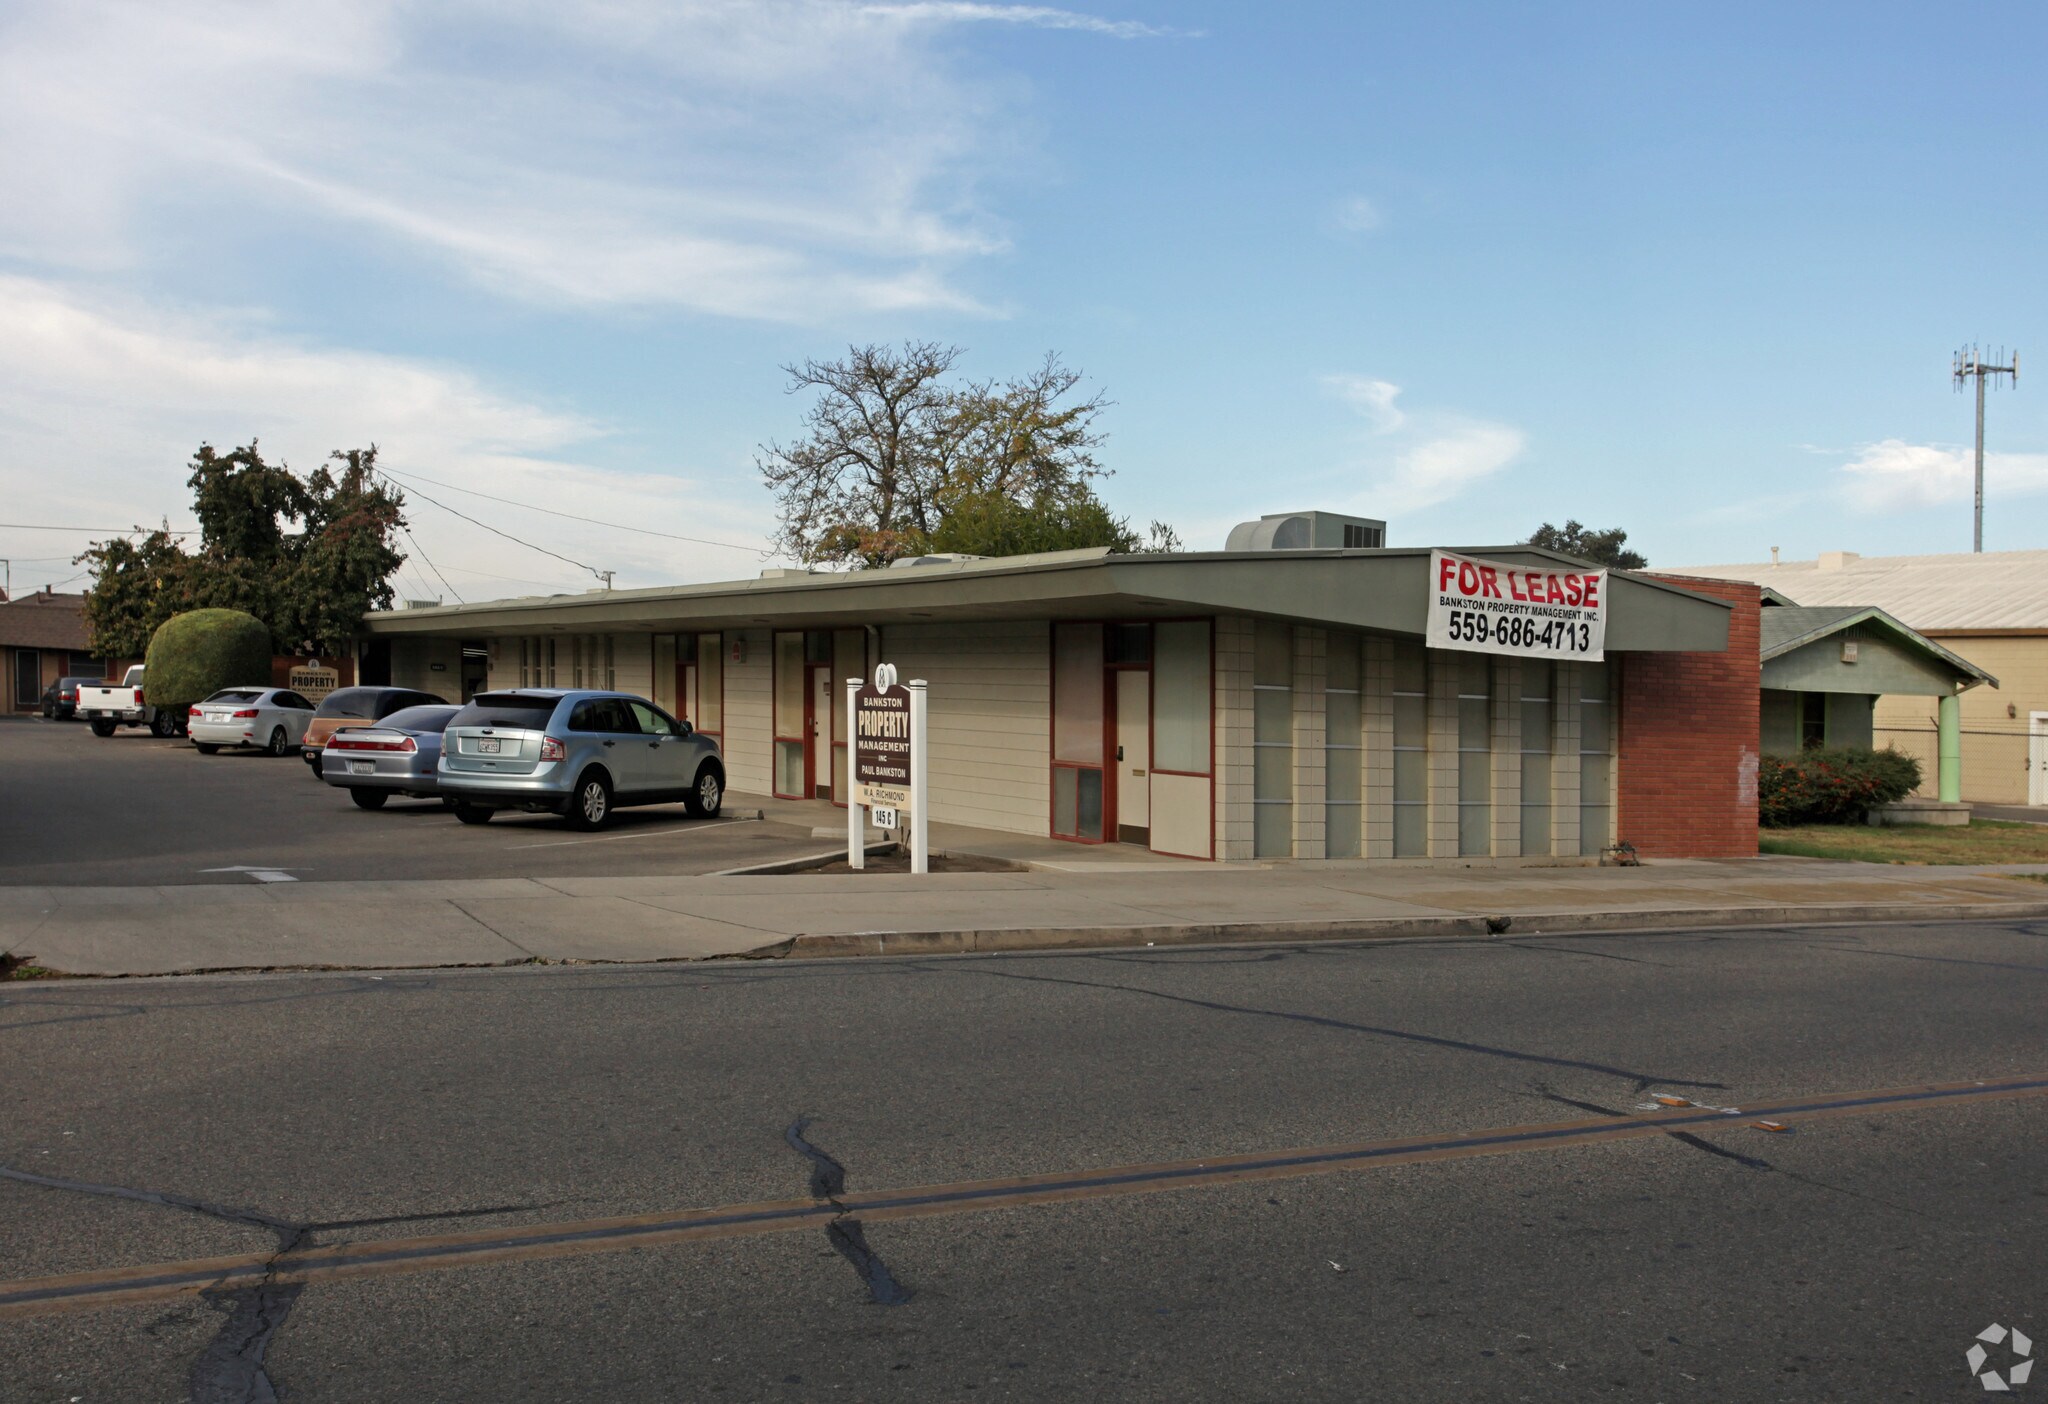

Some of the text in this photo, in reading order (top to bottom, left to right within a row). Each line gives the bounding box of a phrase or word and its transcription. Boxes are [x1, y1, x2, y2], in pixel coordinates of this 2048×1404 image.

[1440, 558, 1599, 608] FOR LEASE
[1440, 596, 1599, 622] BANKSTON PROPERTY MANAGEMENT INC.
[1449, 610, 1590, 652] 559-686-4713
[291, 676, 336, 687] PROPERTY
[863, 697, 903, 707] BANKSTON
[858, 710, 908, 738] PROPERTY
[858, 740, 910, 752] MANAGEMENT
[861, 765, 906, 778] PAUL BANKSTON
[876, 789, 905, 801] RICHMOND
[875, 810, 886, 824] 145
